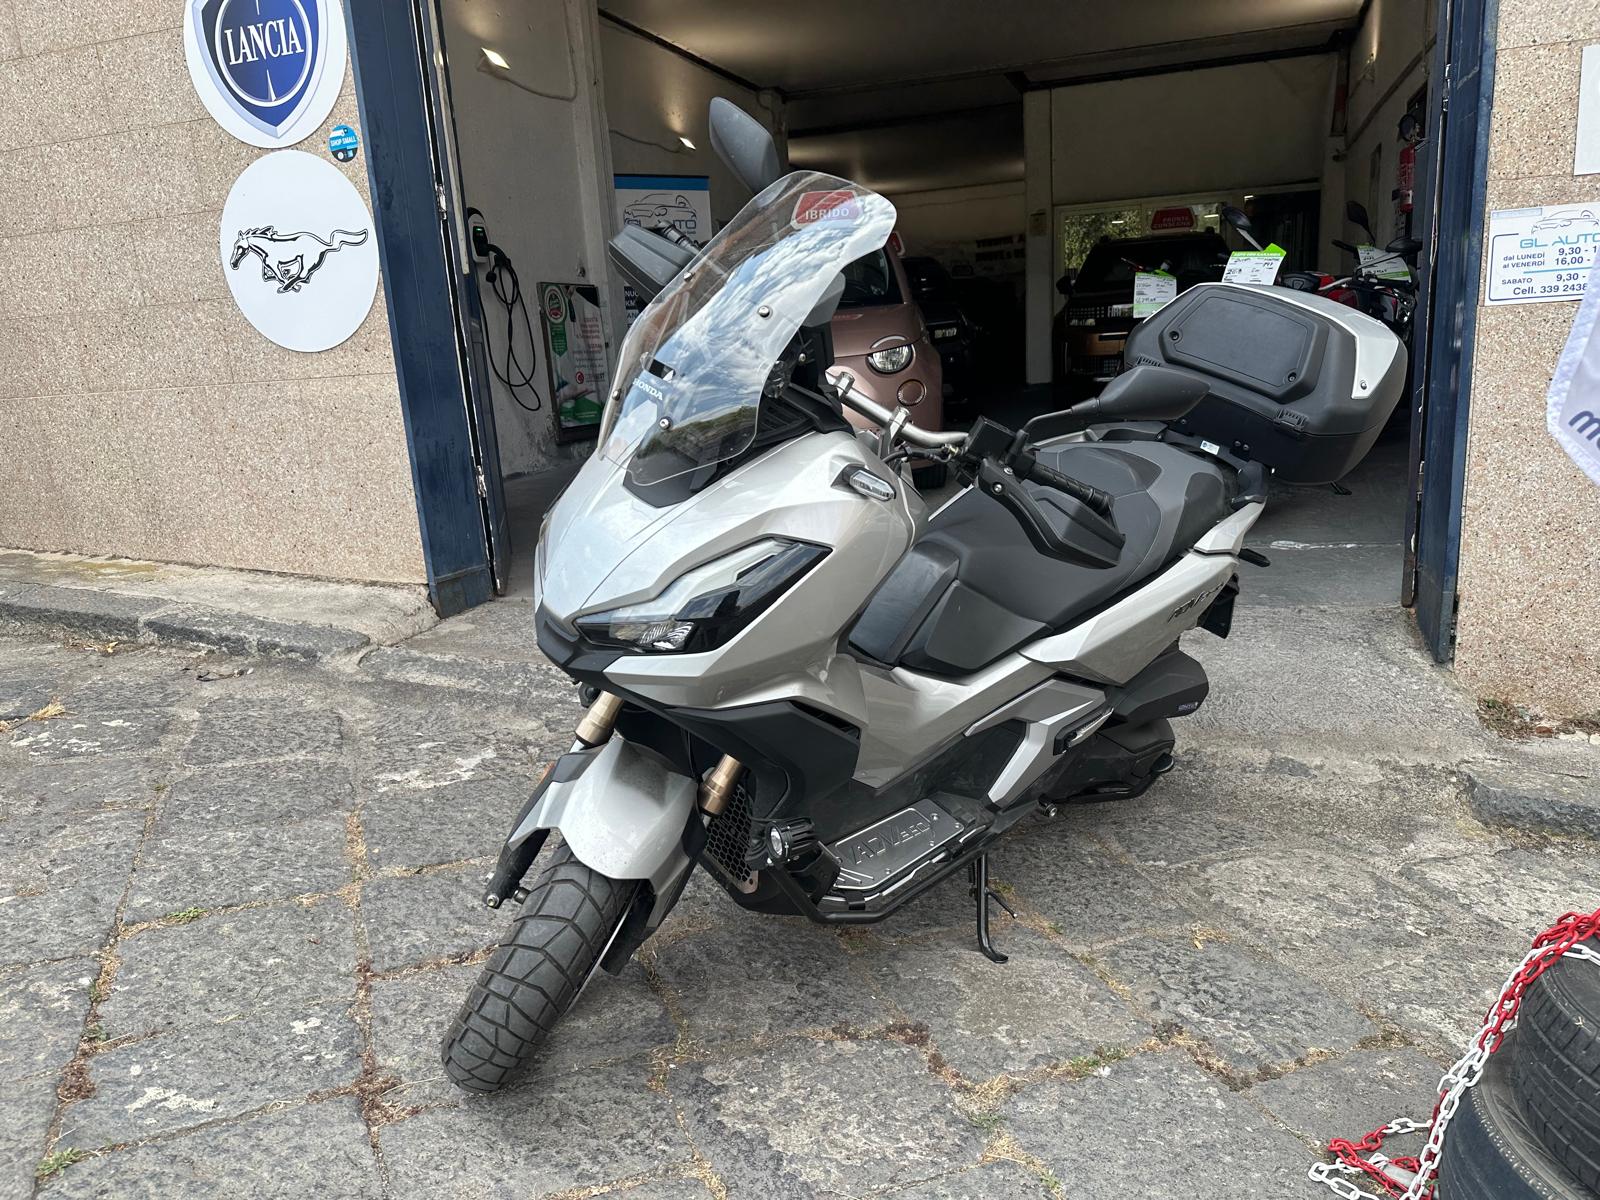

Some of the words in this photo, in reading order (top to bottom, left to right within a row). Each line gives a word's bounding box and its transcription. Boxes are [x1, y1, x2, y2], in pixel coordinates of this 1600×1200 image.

[224, 17, 304, 65] LANCIA
[805, 208, 850, 220] IBRIDO
[1519, 238, 1548, 249] GL
[1558, 246, 1581, 256] 9,30
[1555, 256, 1583, 265] 16,00
[1556, 272, 1579, 282] 9,30
[1513, 286, 1537, 295] Cell.
[1540, 285, 1559, 294] 339
[632, 377, 663, 400] HONDA
